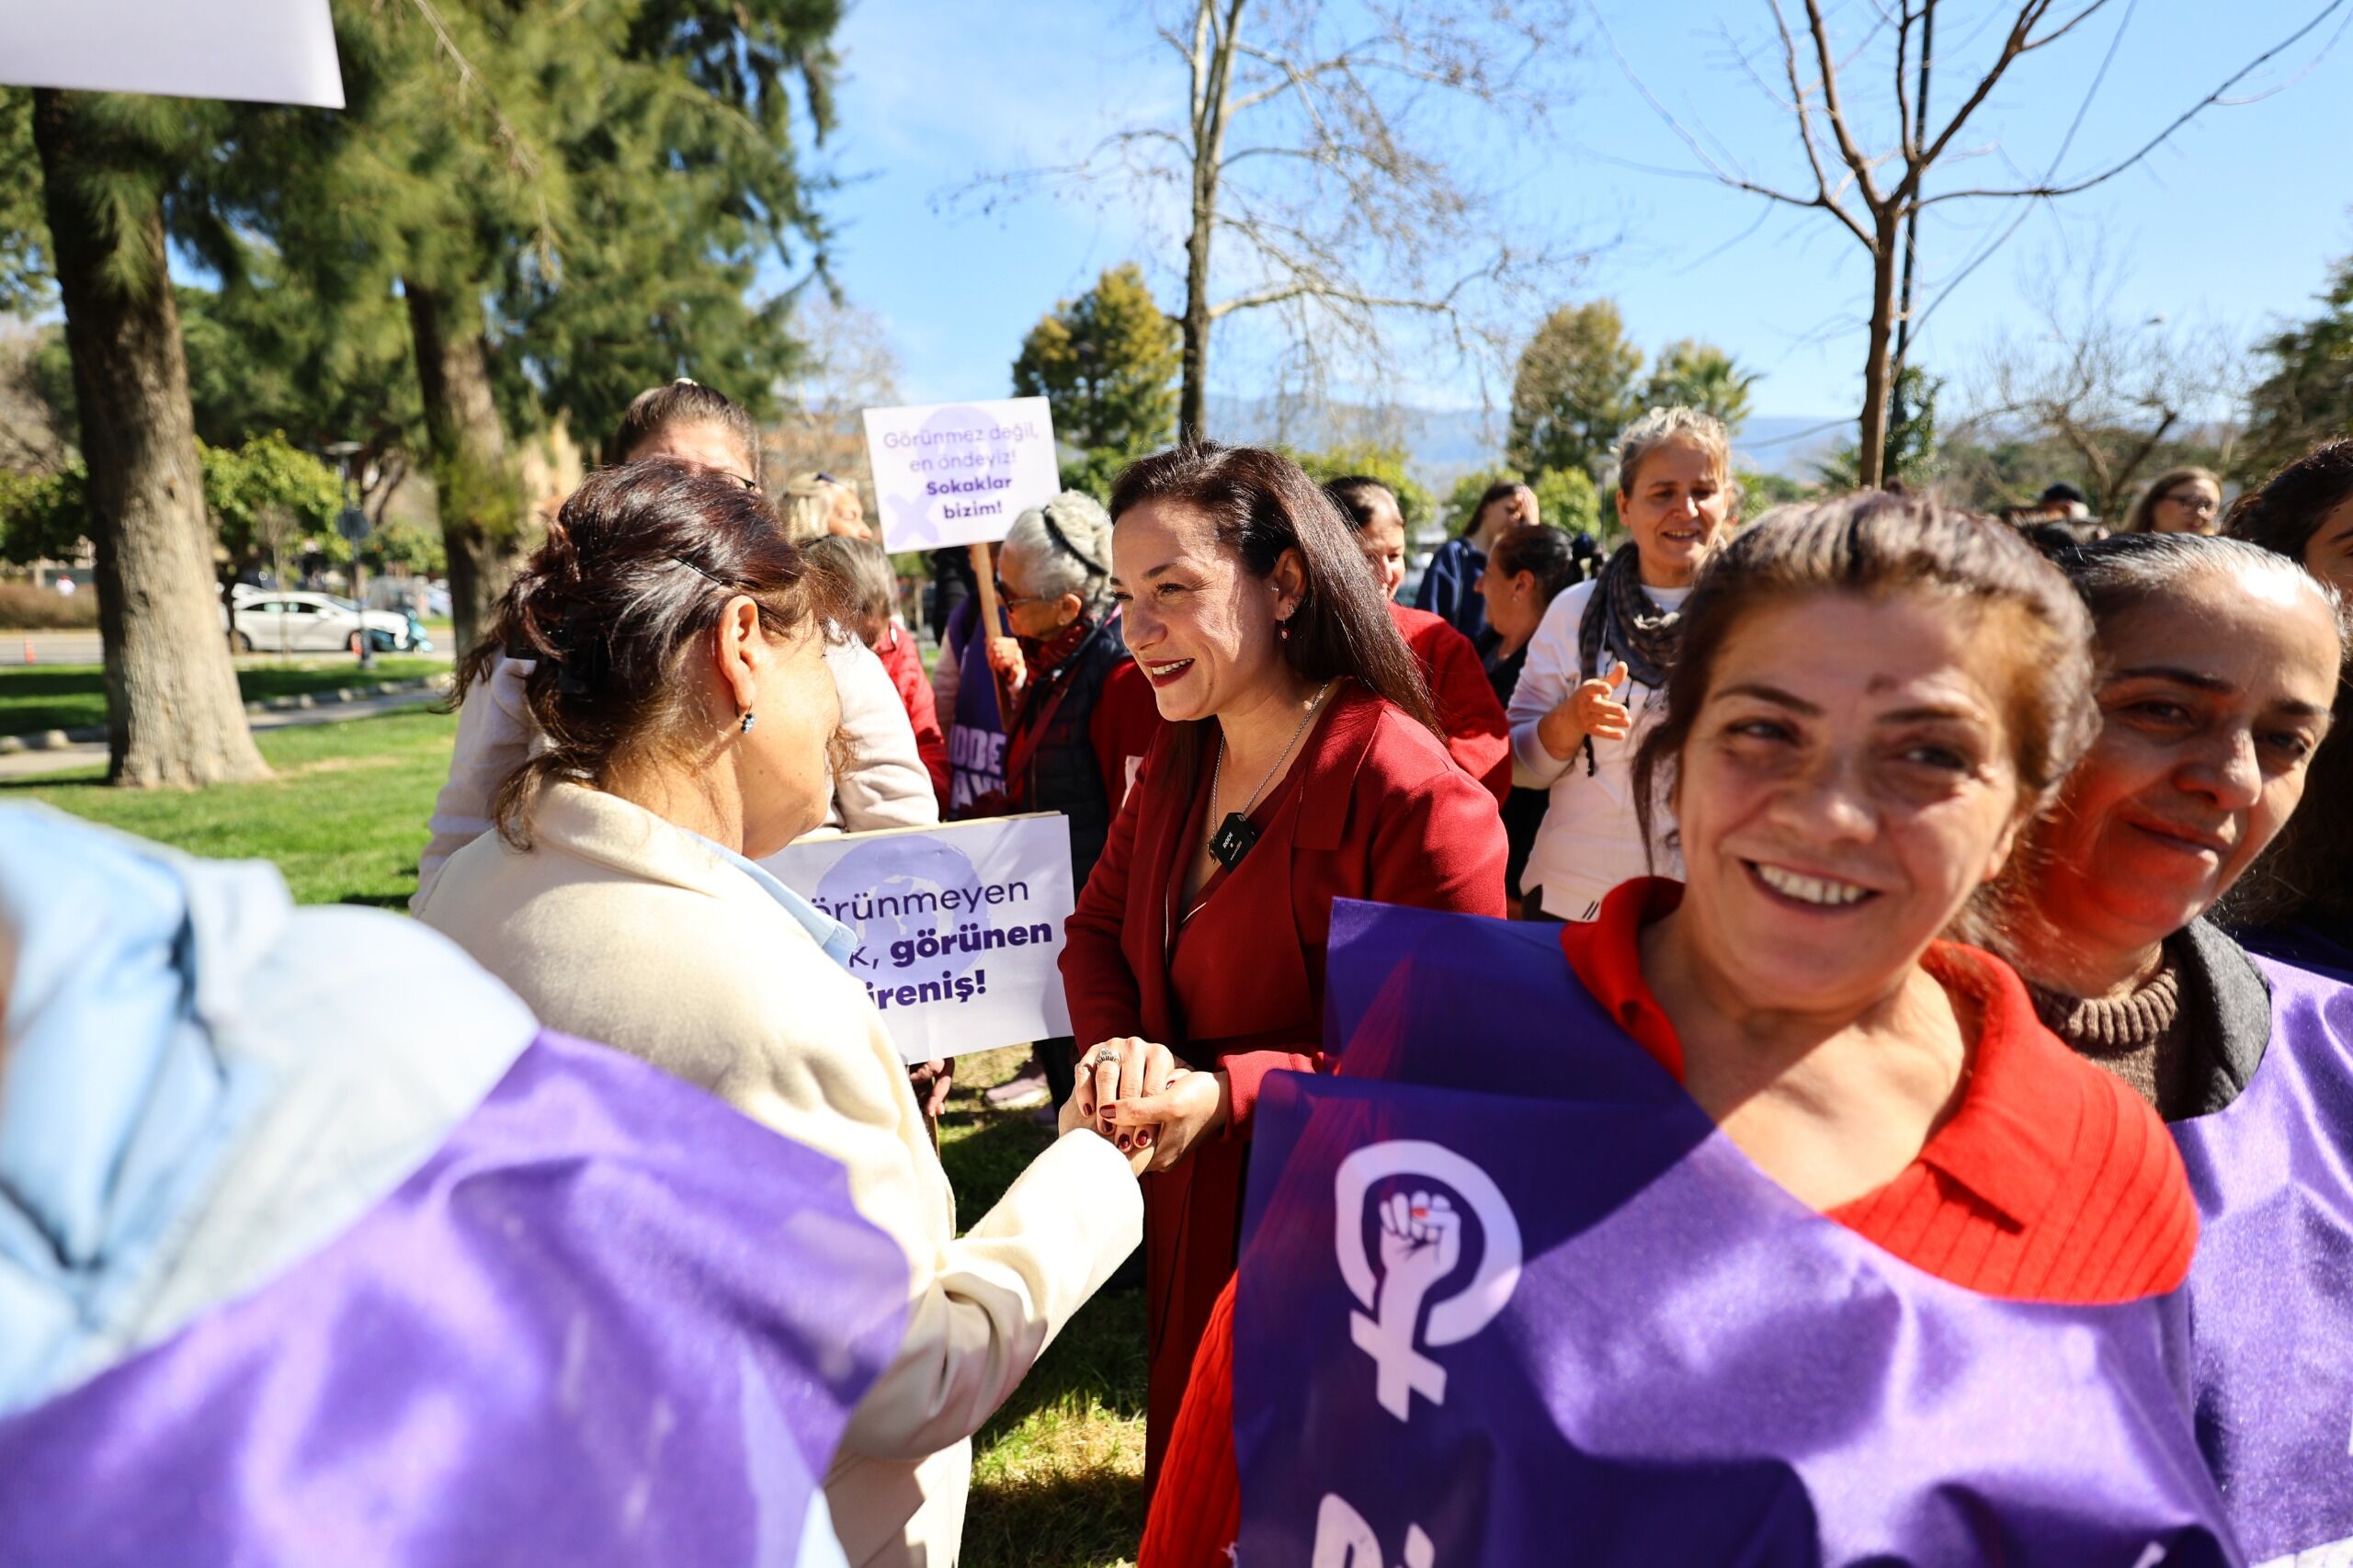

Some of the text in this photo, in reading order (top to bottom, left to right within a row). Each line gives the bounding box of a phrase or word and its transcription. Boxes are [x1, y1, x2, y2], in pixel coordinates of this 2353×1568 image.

[883, 422, 1039, 449] Görünmez değil,
[910, 449, 1017, 472] en öndeyiz!
[926, 475, 1012, 495] Sokaklar
[943, 500, 1003, 519] bizim!
[811, 881, 1029, 921] örünmeyen
[890, 921, 1052, 968] görünen
[866, 969, 986, 1009] ireniş!
